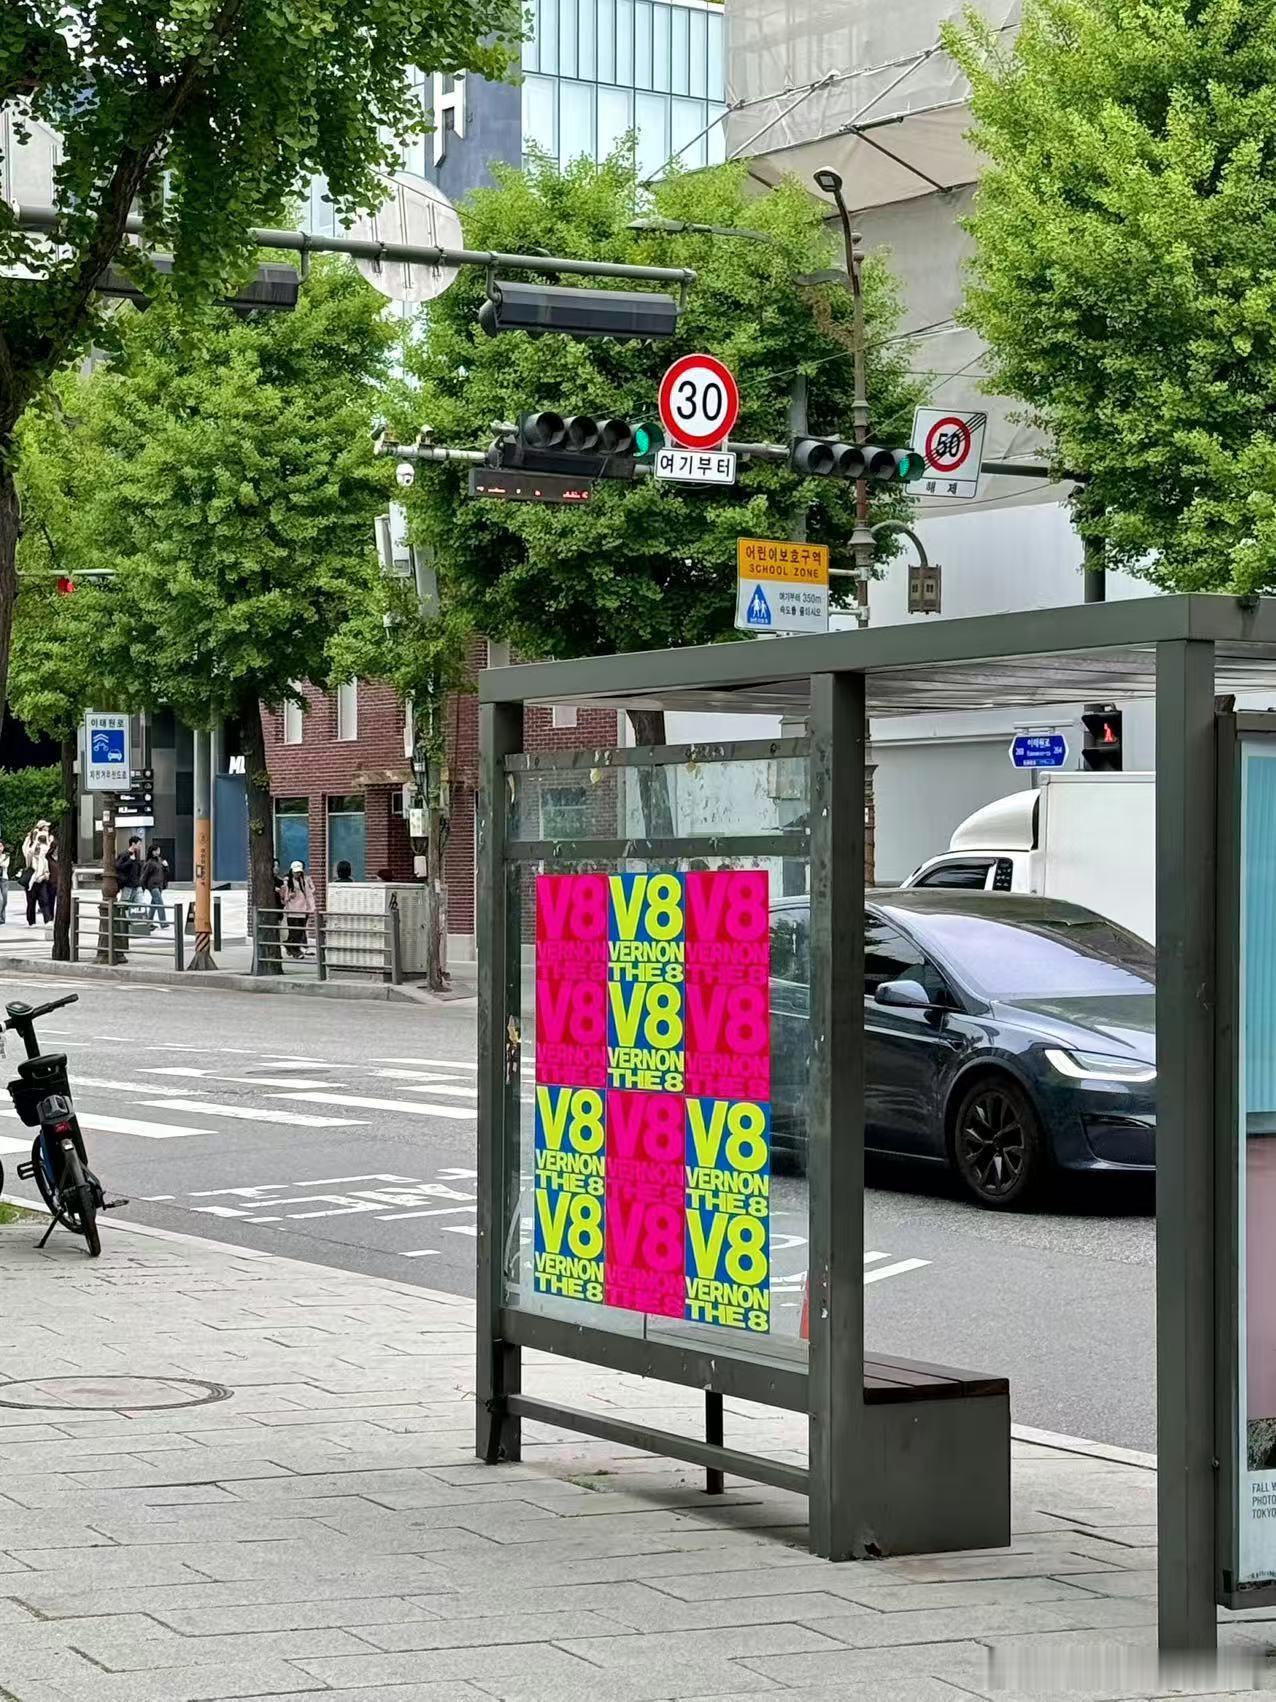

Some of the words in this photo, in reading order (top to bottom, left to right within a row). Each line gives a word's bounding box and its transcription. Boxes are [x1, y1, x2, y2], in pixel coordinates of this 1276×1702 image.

[677, 381, 722, 421] 30
[936, 432, 960, 458] 50
[660, 454, 730, 477] 여기부터
[745, 545, 822, 566] 어린이보호구역
[749, 563, 788, 576] SCHOOL
[794, 567, 819, 578] ZONE
[537, 875, 605, 940] V8
[609, 873, 683, 940] V8
[684, 872, 767, 942] V8
[609, 941, 684, 962] VERNON
[537, 979, 604, 1045] V8
[609, 982, 683, 1050] V8
[684, 983, 766, 1054] V8
[609, 1047, 684, 1072] VERNON
[536, 1086, 604, 1154] V8
[606, 1091, 682, 1161] V8
[686, 1098, 767, 1172] V8
[536, 1149, 605, 1177] VERNON
[686, 1166, 769, 1197] VERNON
[536, 1188, 603, 1259] V8
[605, 1196, 682, 1272] V8
[535, 1251, 604, 1283] VERNON
[686, 1208, 767, 1286] V8
[686, 1276, 769, 1311] VERNON
[1252, 1482, 1270, 1493] FALL
[1252, 1508, 1276, 1519] TOKYO
